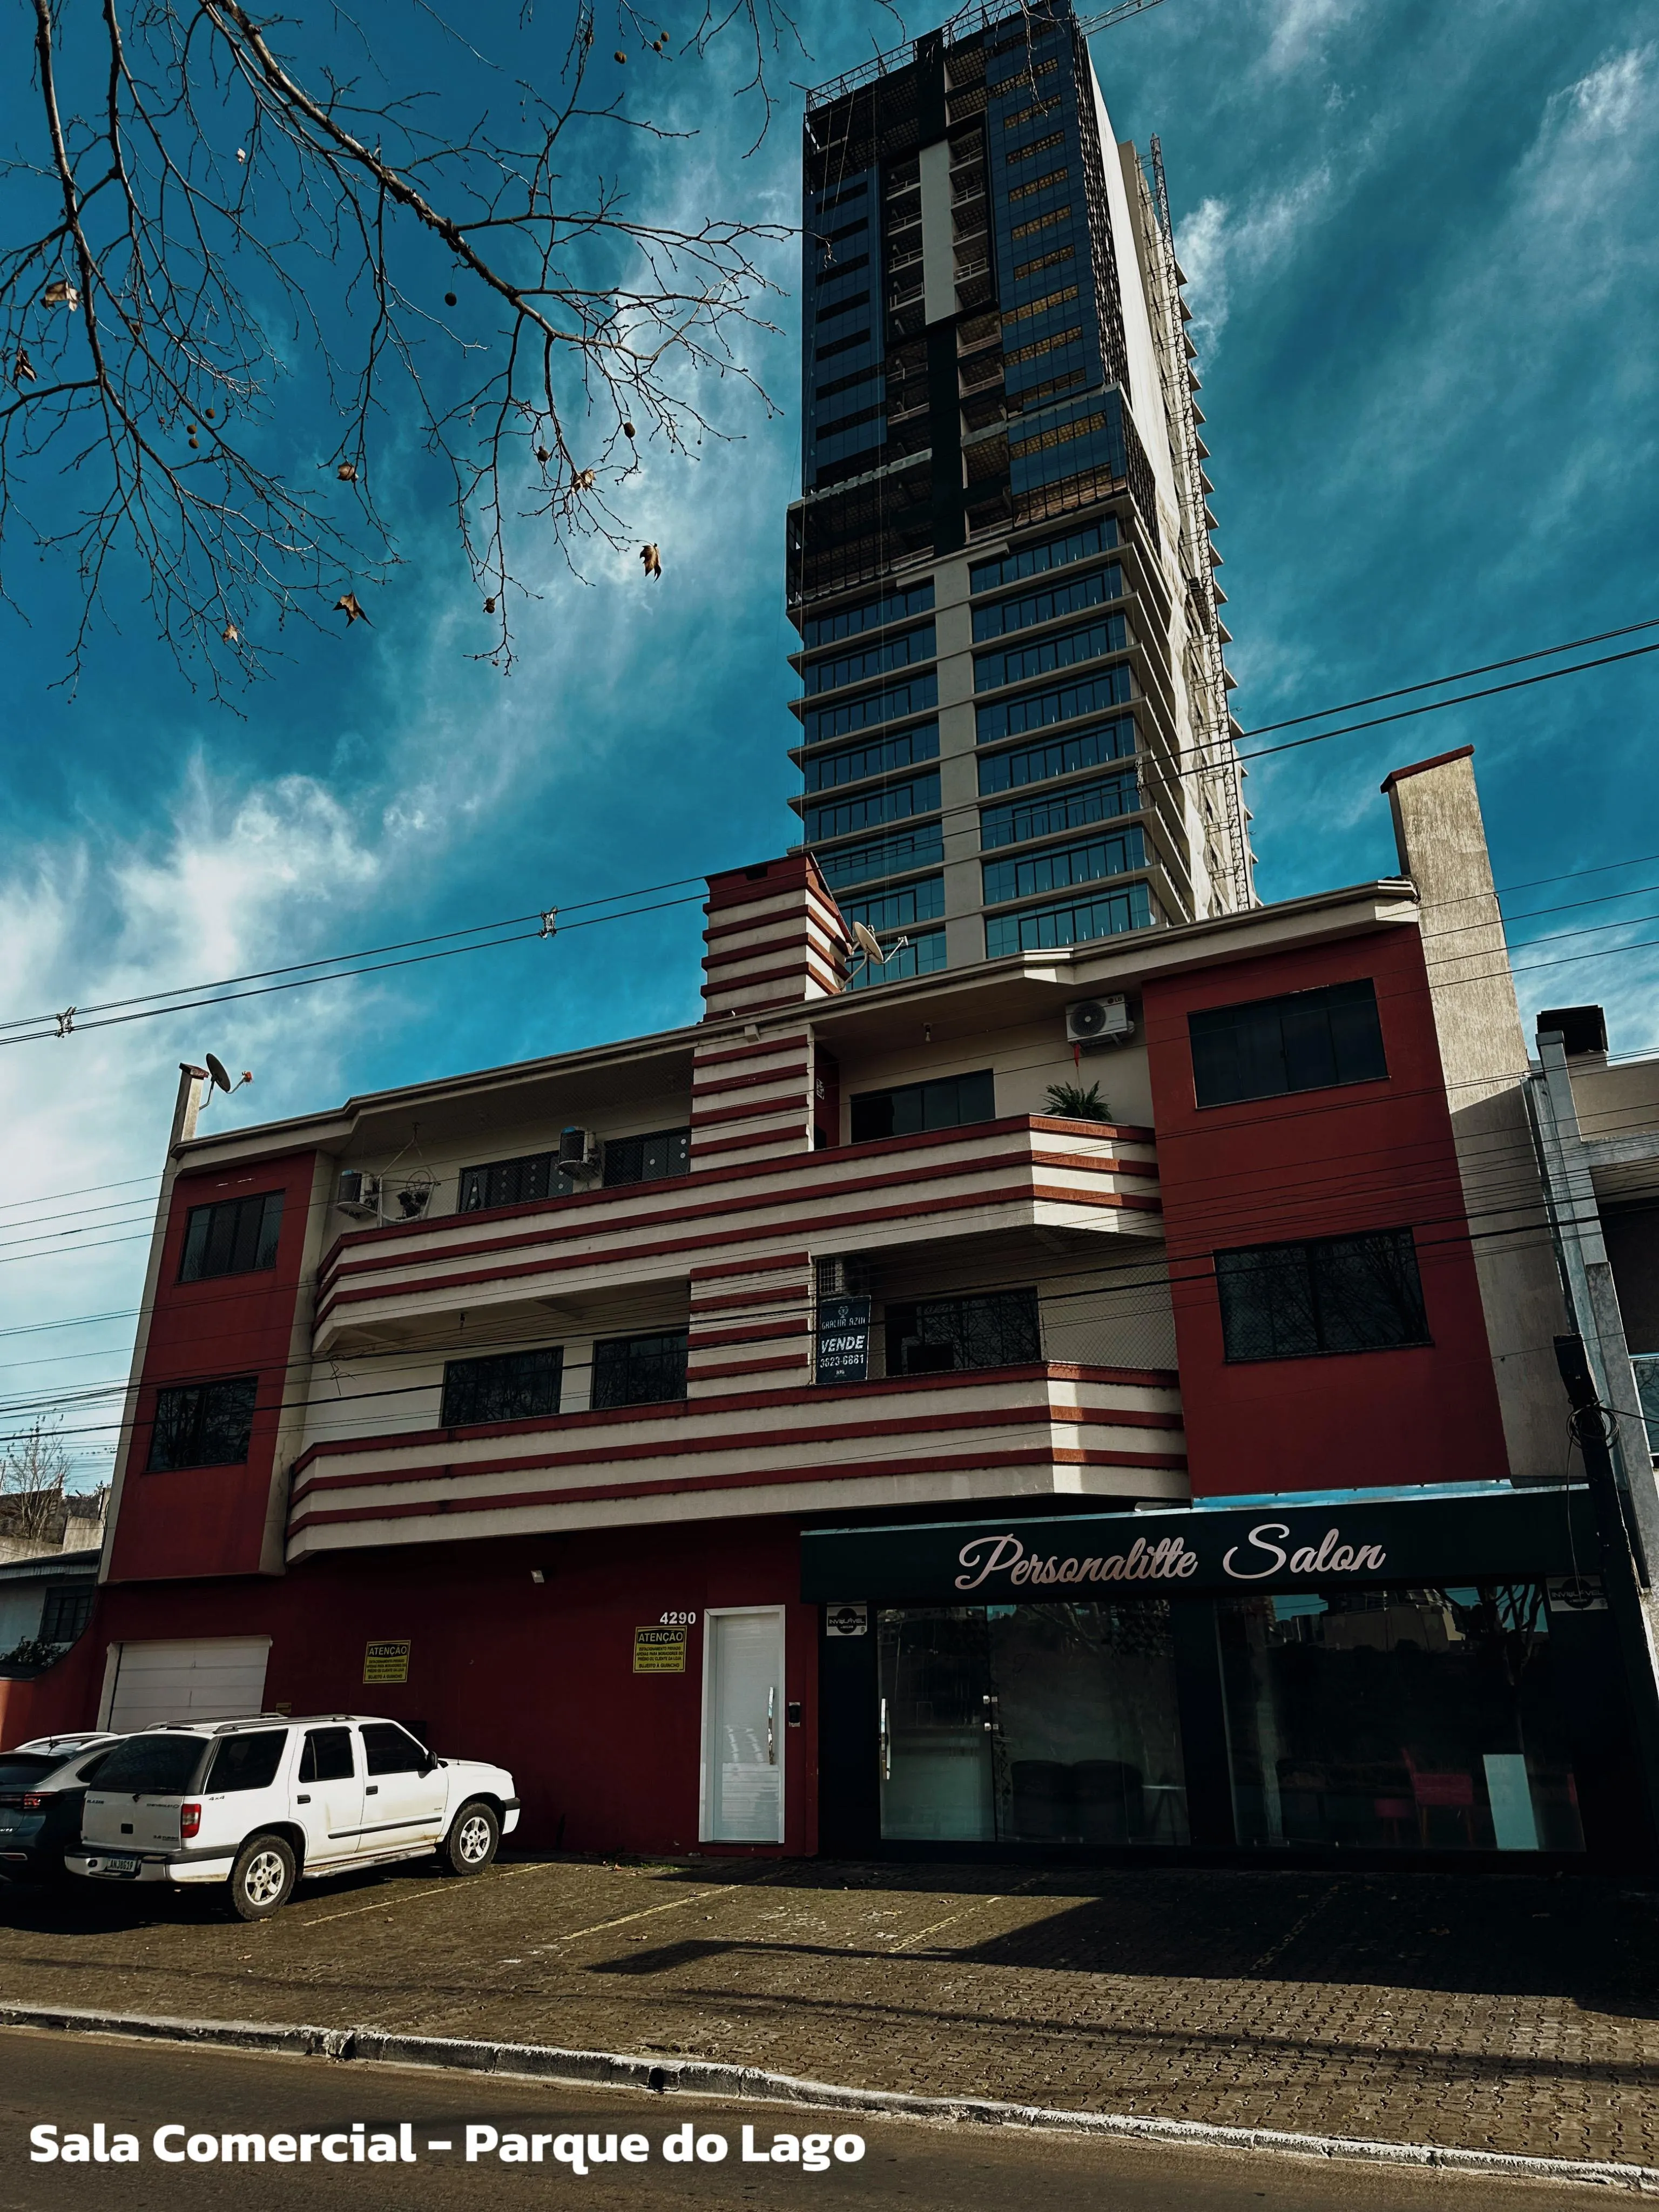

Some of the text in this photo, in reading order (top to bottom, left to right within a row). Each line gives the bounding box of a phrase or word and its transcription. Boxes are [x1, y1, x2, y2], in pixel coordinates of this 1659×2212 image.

[821, 1335, 865, 1353] VENDE
[955, 1523, 1387, 1590] Personalitte Salon
[660, 1611, 696, 1624] 4290
[638, 1631, 683, 1644] ATENÇÃO
[369, 1645, 407, 1656] ATENÇÃO
